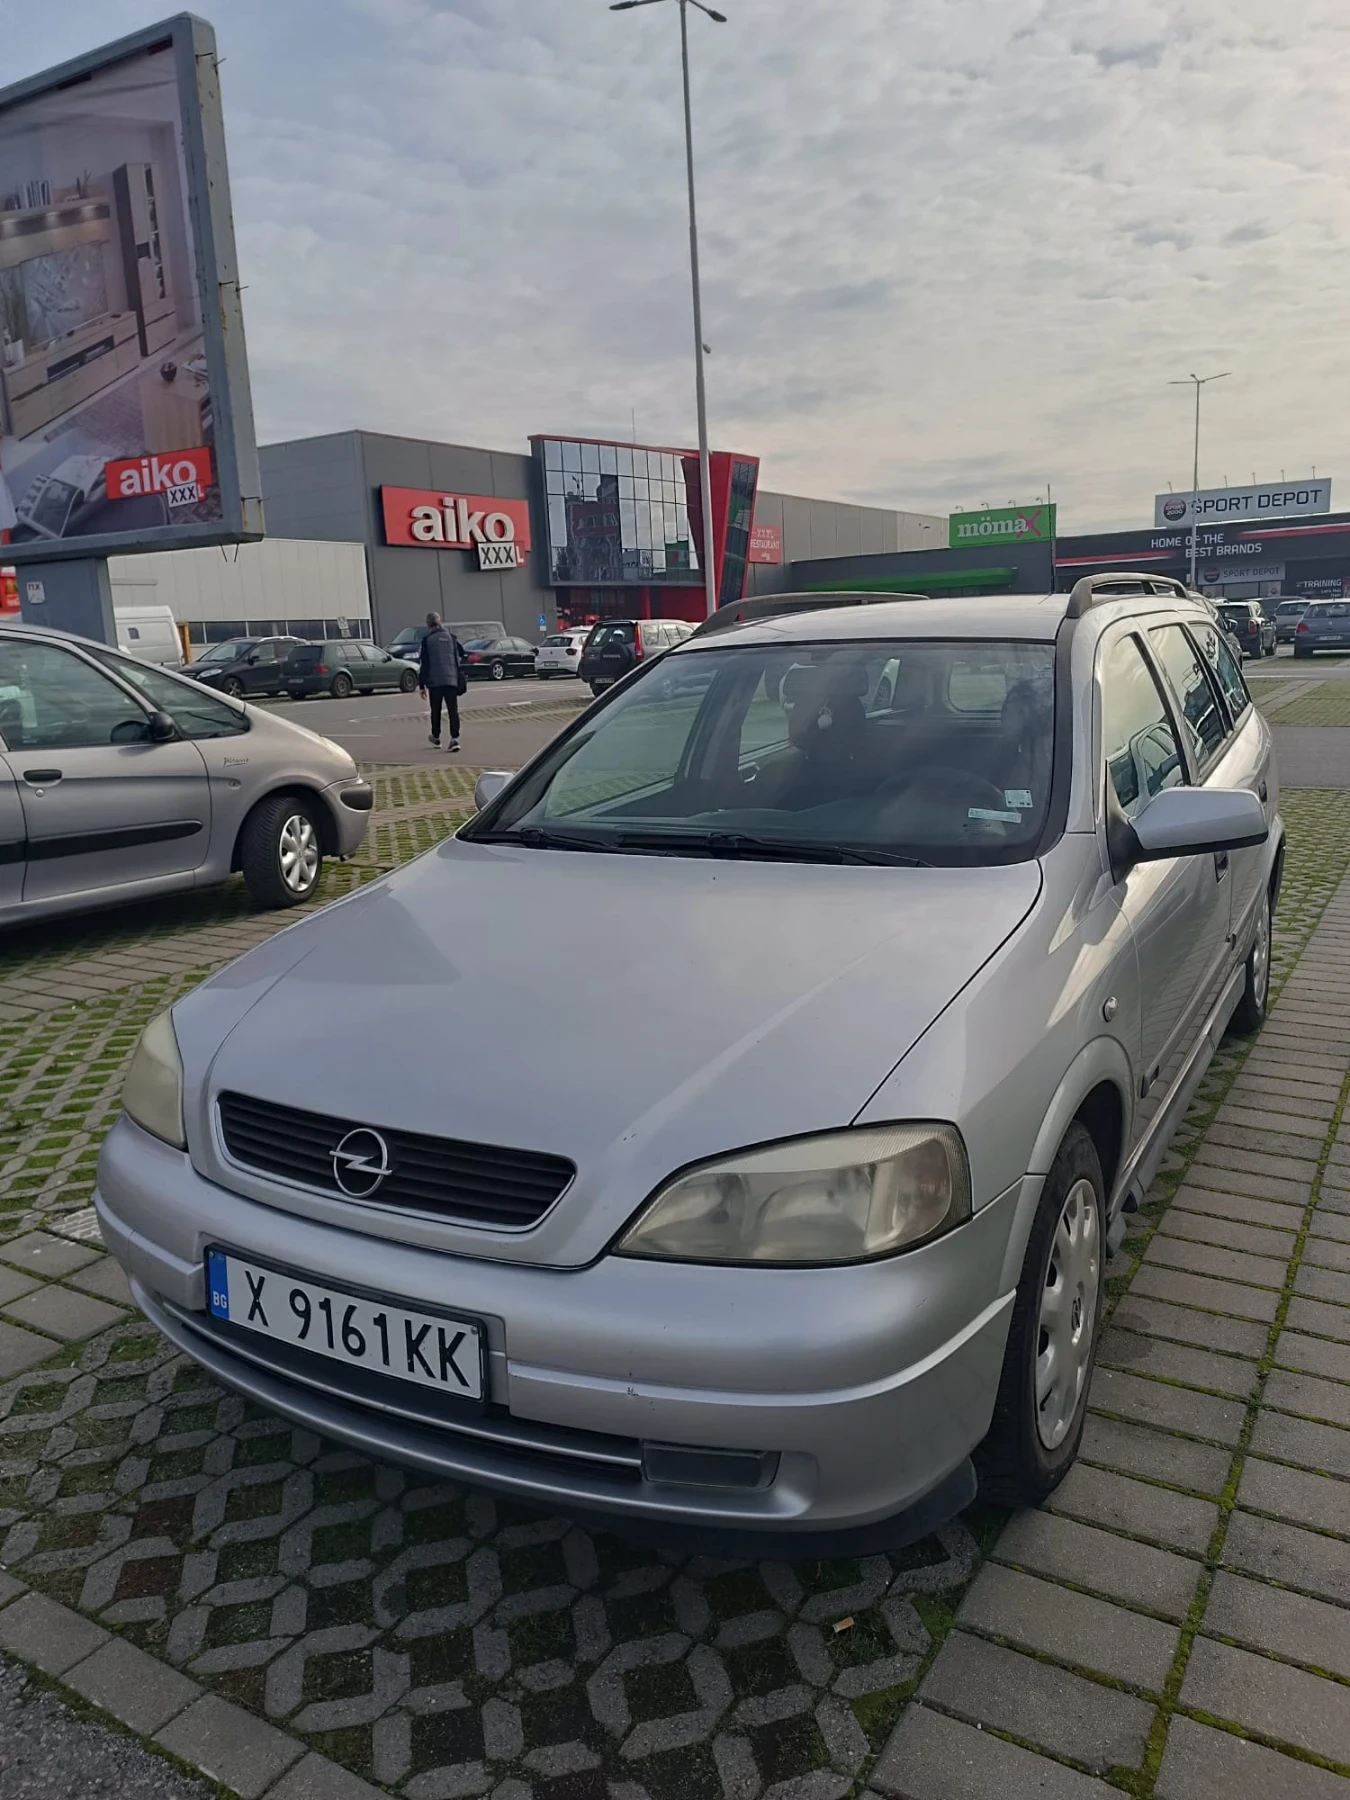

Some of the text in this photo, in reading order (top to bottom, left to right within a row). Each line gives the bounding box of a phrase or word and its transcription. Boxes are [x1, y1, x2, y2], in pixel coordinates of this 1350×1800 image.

[120, 457, 196, 495] aiko
[1191, 489, 1322, 514] SPORT DEPOT
[411, 497, 514, 542] aiko
[1151, 537, 1182, 549] HOME
[1203, 533, 1225, 545] THE
[1186, 543, 1262, 558] BEST BRANDS
[481, 545, 524, 565] XXXL
[1223, 568, 1250, 577] SPORT
[1253, 566, 1280, 575] DEPOT
[1303, 578, 1342, 588] TRAINING
[212, 1290, 228, 1310] BG
